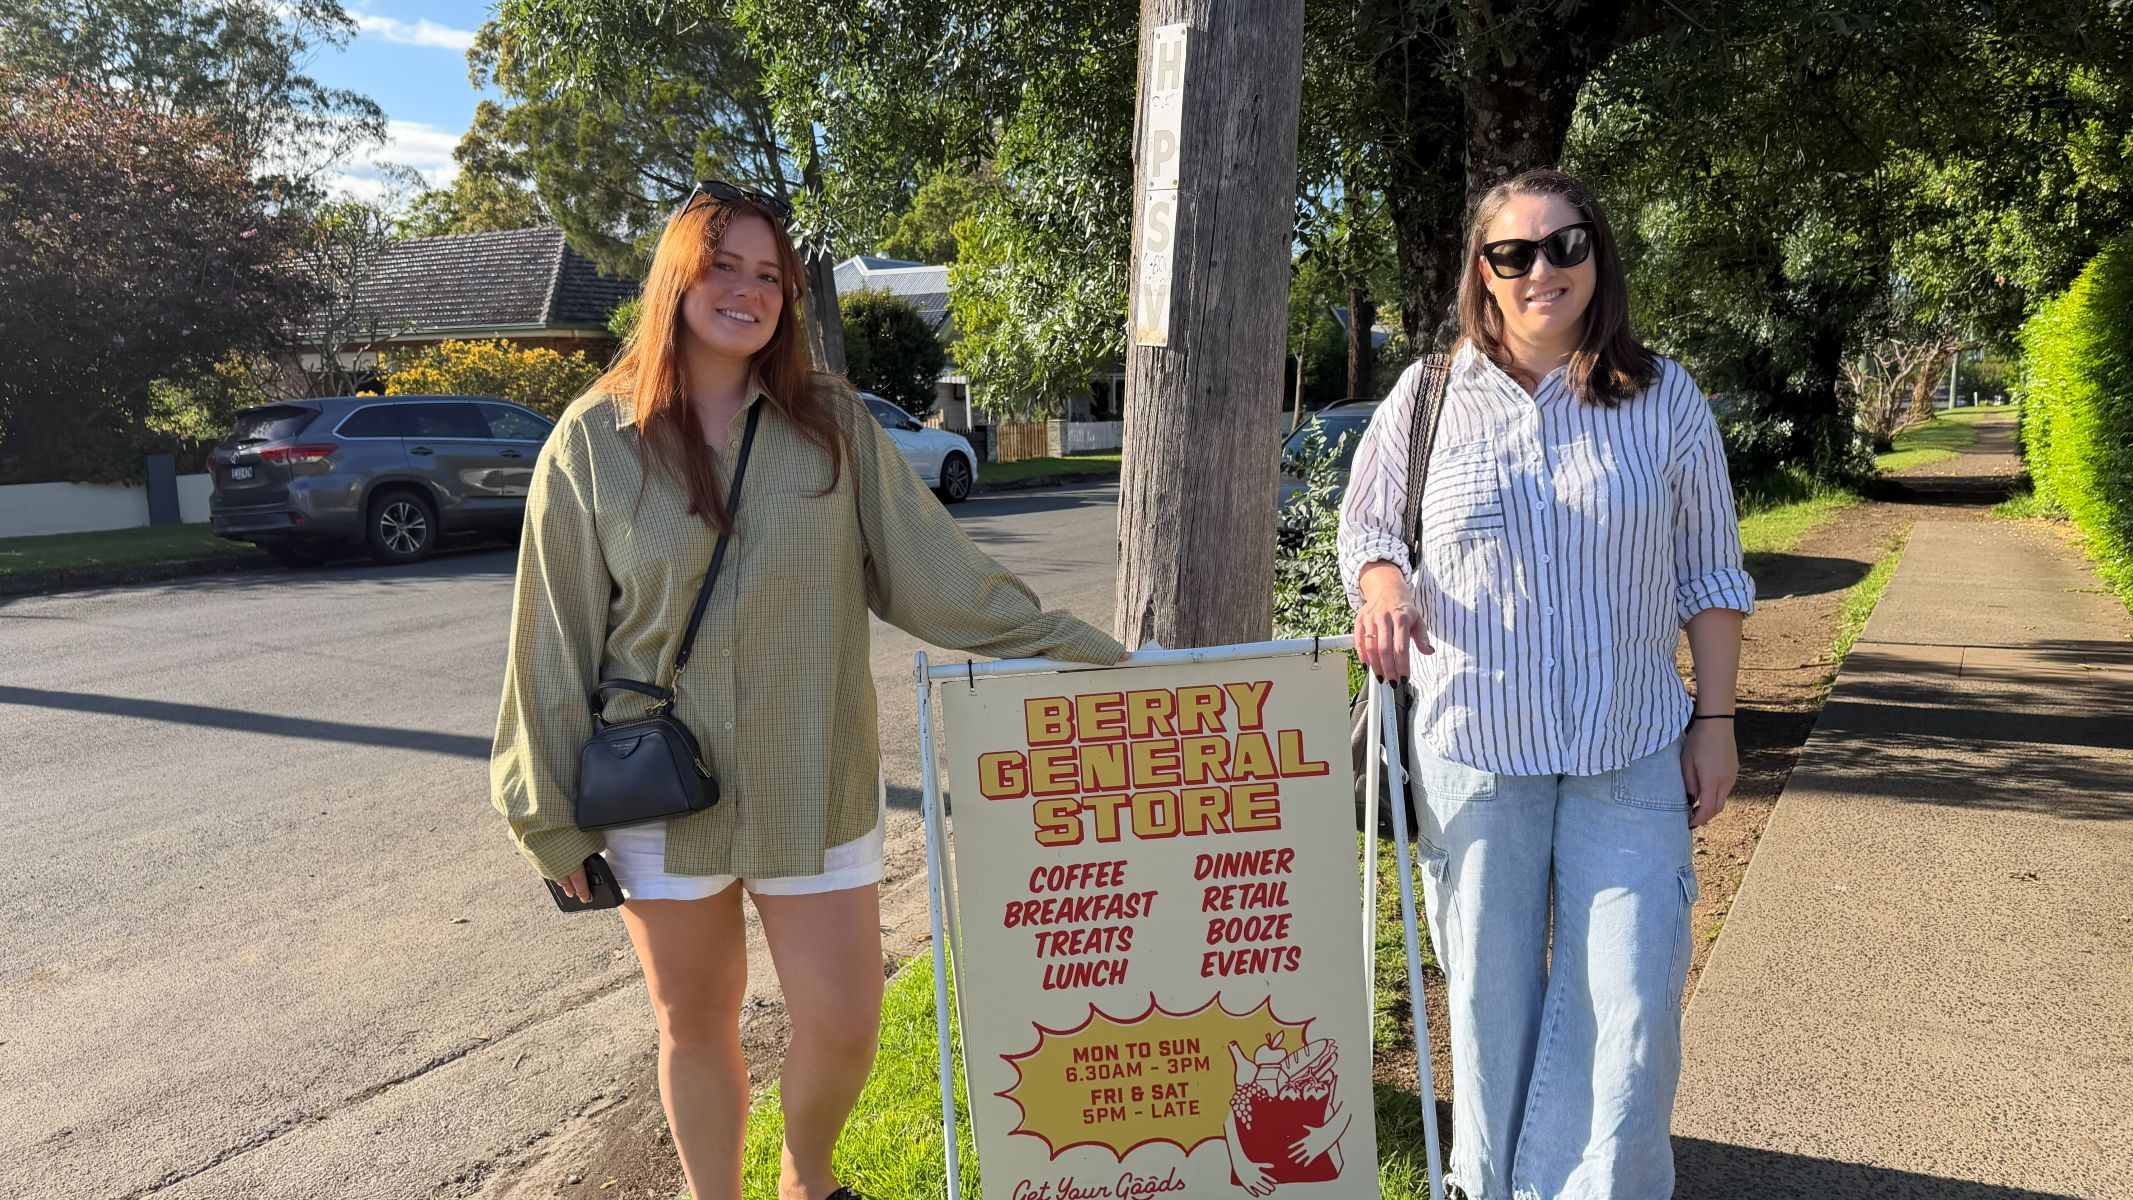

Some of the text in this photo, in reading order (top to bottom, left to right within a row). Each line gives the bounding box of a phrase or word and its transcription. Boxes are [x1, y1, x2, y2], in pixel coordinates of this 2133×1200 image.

[1024, 681, 1273, 747] BERRY
[978, 729, 1330, 800] GENERAL
[1033, 782, 1281, 847] STORE
[1029, 860, 1128, 894] COFFEE
[1194, 847, 1295, 880] DINNER
[1003, 891, 1158, 929] BREAKFAST
[1202, 881, 1289, 912] RETAIL
[1035, 926, 1133, 959] TREATS
[1207, 913, 1292, 946] BOOZE
[1042, 958, 1128, 990] LUNCH
[1201, 945, 1301, 978] EVENTS
[1073, 1038, 1200, 1063] MON TO SUN
[1066, 1062, 1142, 1083] 6.30AM
[1168, 1056, 1210, 1074] 3PM
[1091, 1082, 1189, 1105] FRI & SAT
[1083, 1106, 1126, 1124] 5PM
[1152, 1100, 1200, 1118] LATE
[1012, 1179, 1051, 1200] Get
[1056, 1176, 1112, 1200] Your
